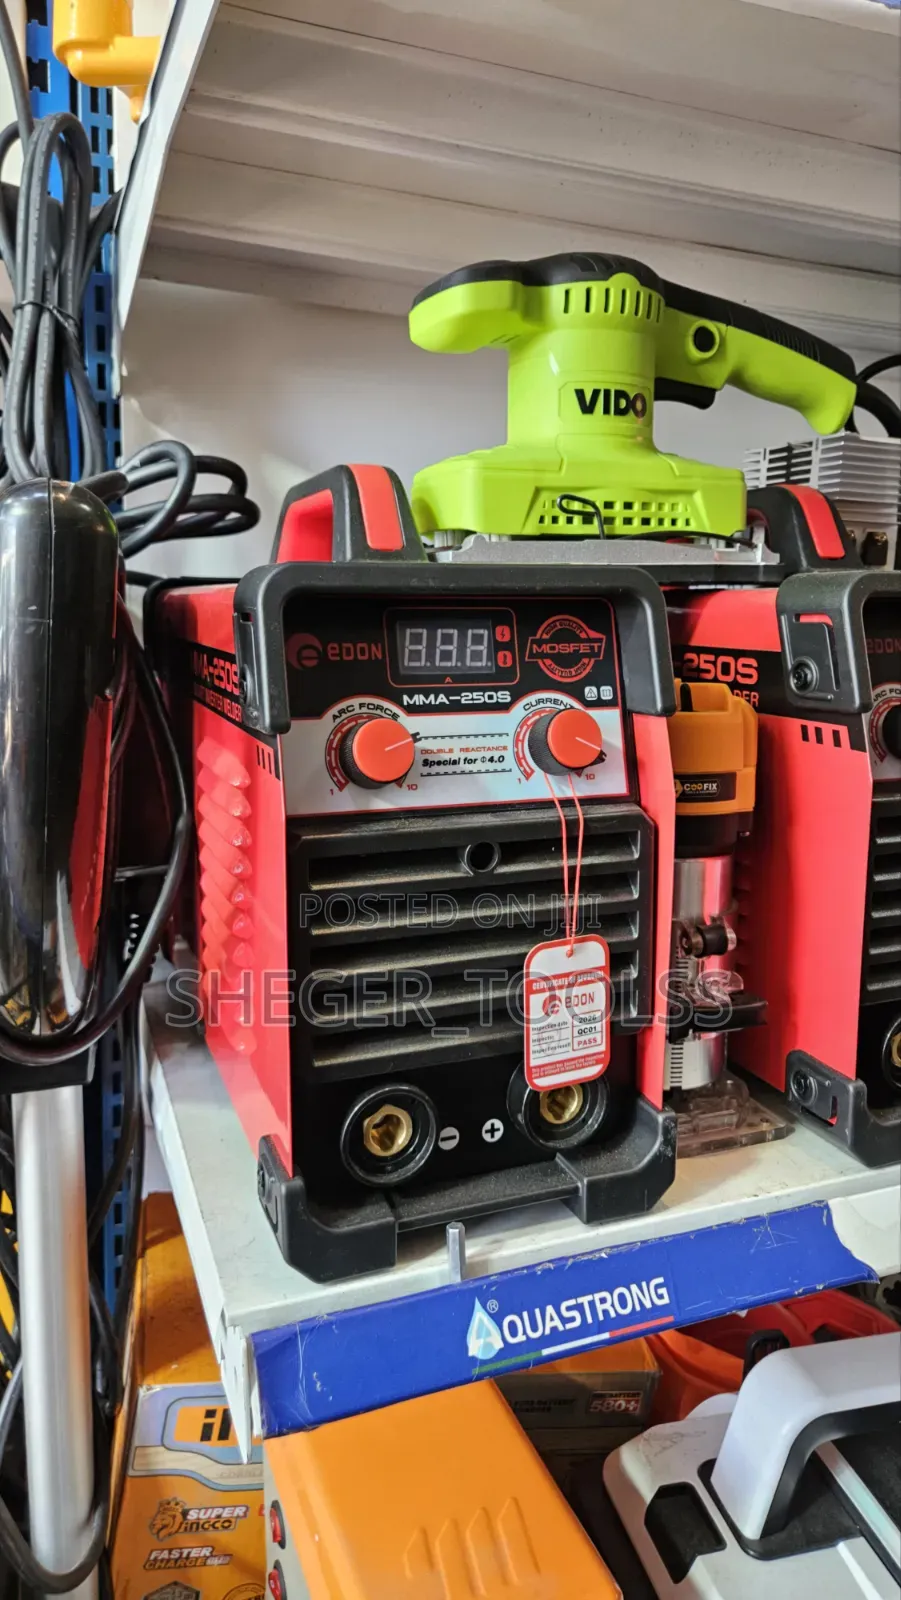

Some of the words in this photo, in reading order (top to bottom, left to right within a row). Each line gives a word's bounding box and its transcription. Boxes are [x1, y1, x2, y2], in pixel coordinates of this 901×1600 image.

[574, 388, 647, 418] VIDO
[532, 643, 601, 654] MOSFET
[402, 690, 511, 706] MMA-250S
[332, 704, 355, 723] ARC
[359, 702, 400, 722] FORCE
[421, 747, 454, 755] DOUBLE
[459, 745, 508, 753] REACTANCE
[422, 757, 461, 768] Special
[463, 756, 478, 765] for
[585, 773, 596, 781] 10
[407, 783, 418, 791] 10
[533, 977, 568, 990] CERTIFICATE
[577, 1025, 597, 1035] QC01
[577, 1037, 598, 1047] PASS
[468, 1277, 670, 1357] AQUASTRONG
[589, 1399, 639, 1413] 580+
[187, 1506, 247, 1519] SUPER
[149, 1547, 213, 1560] FASTER
[145, 1557, 205, 1570] CHARGE
